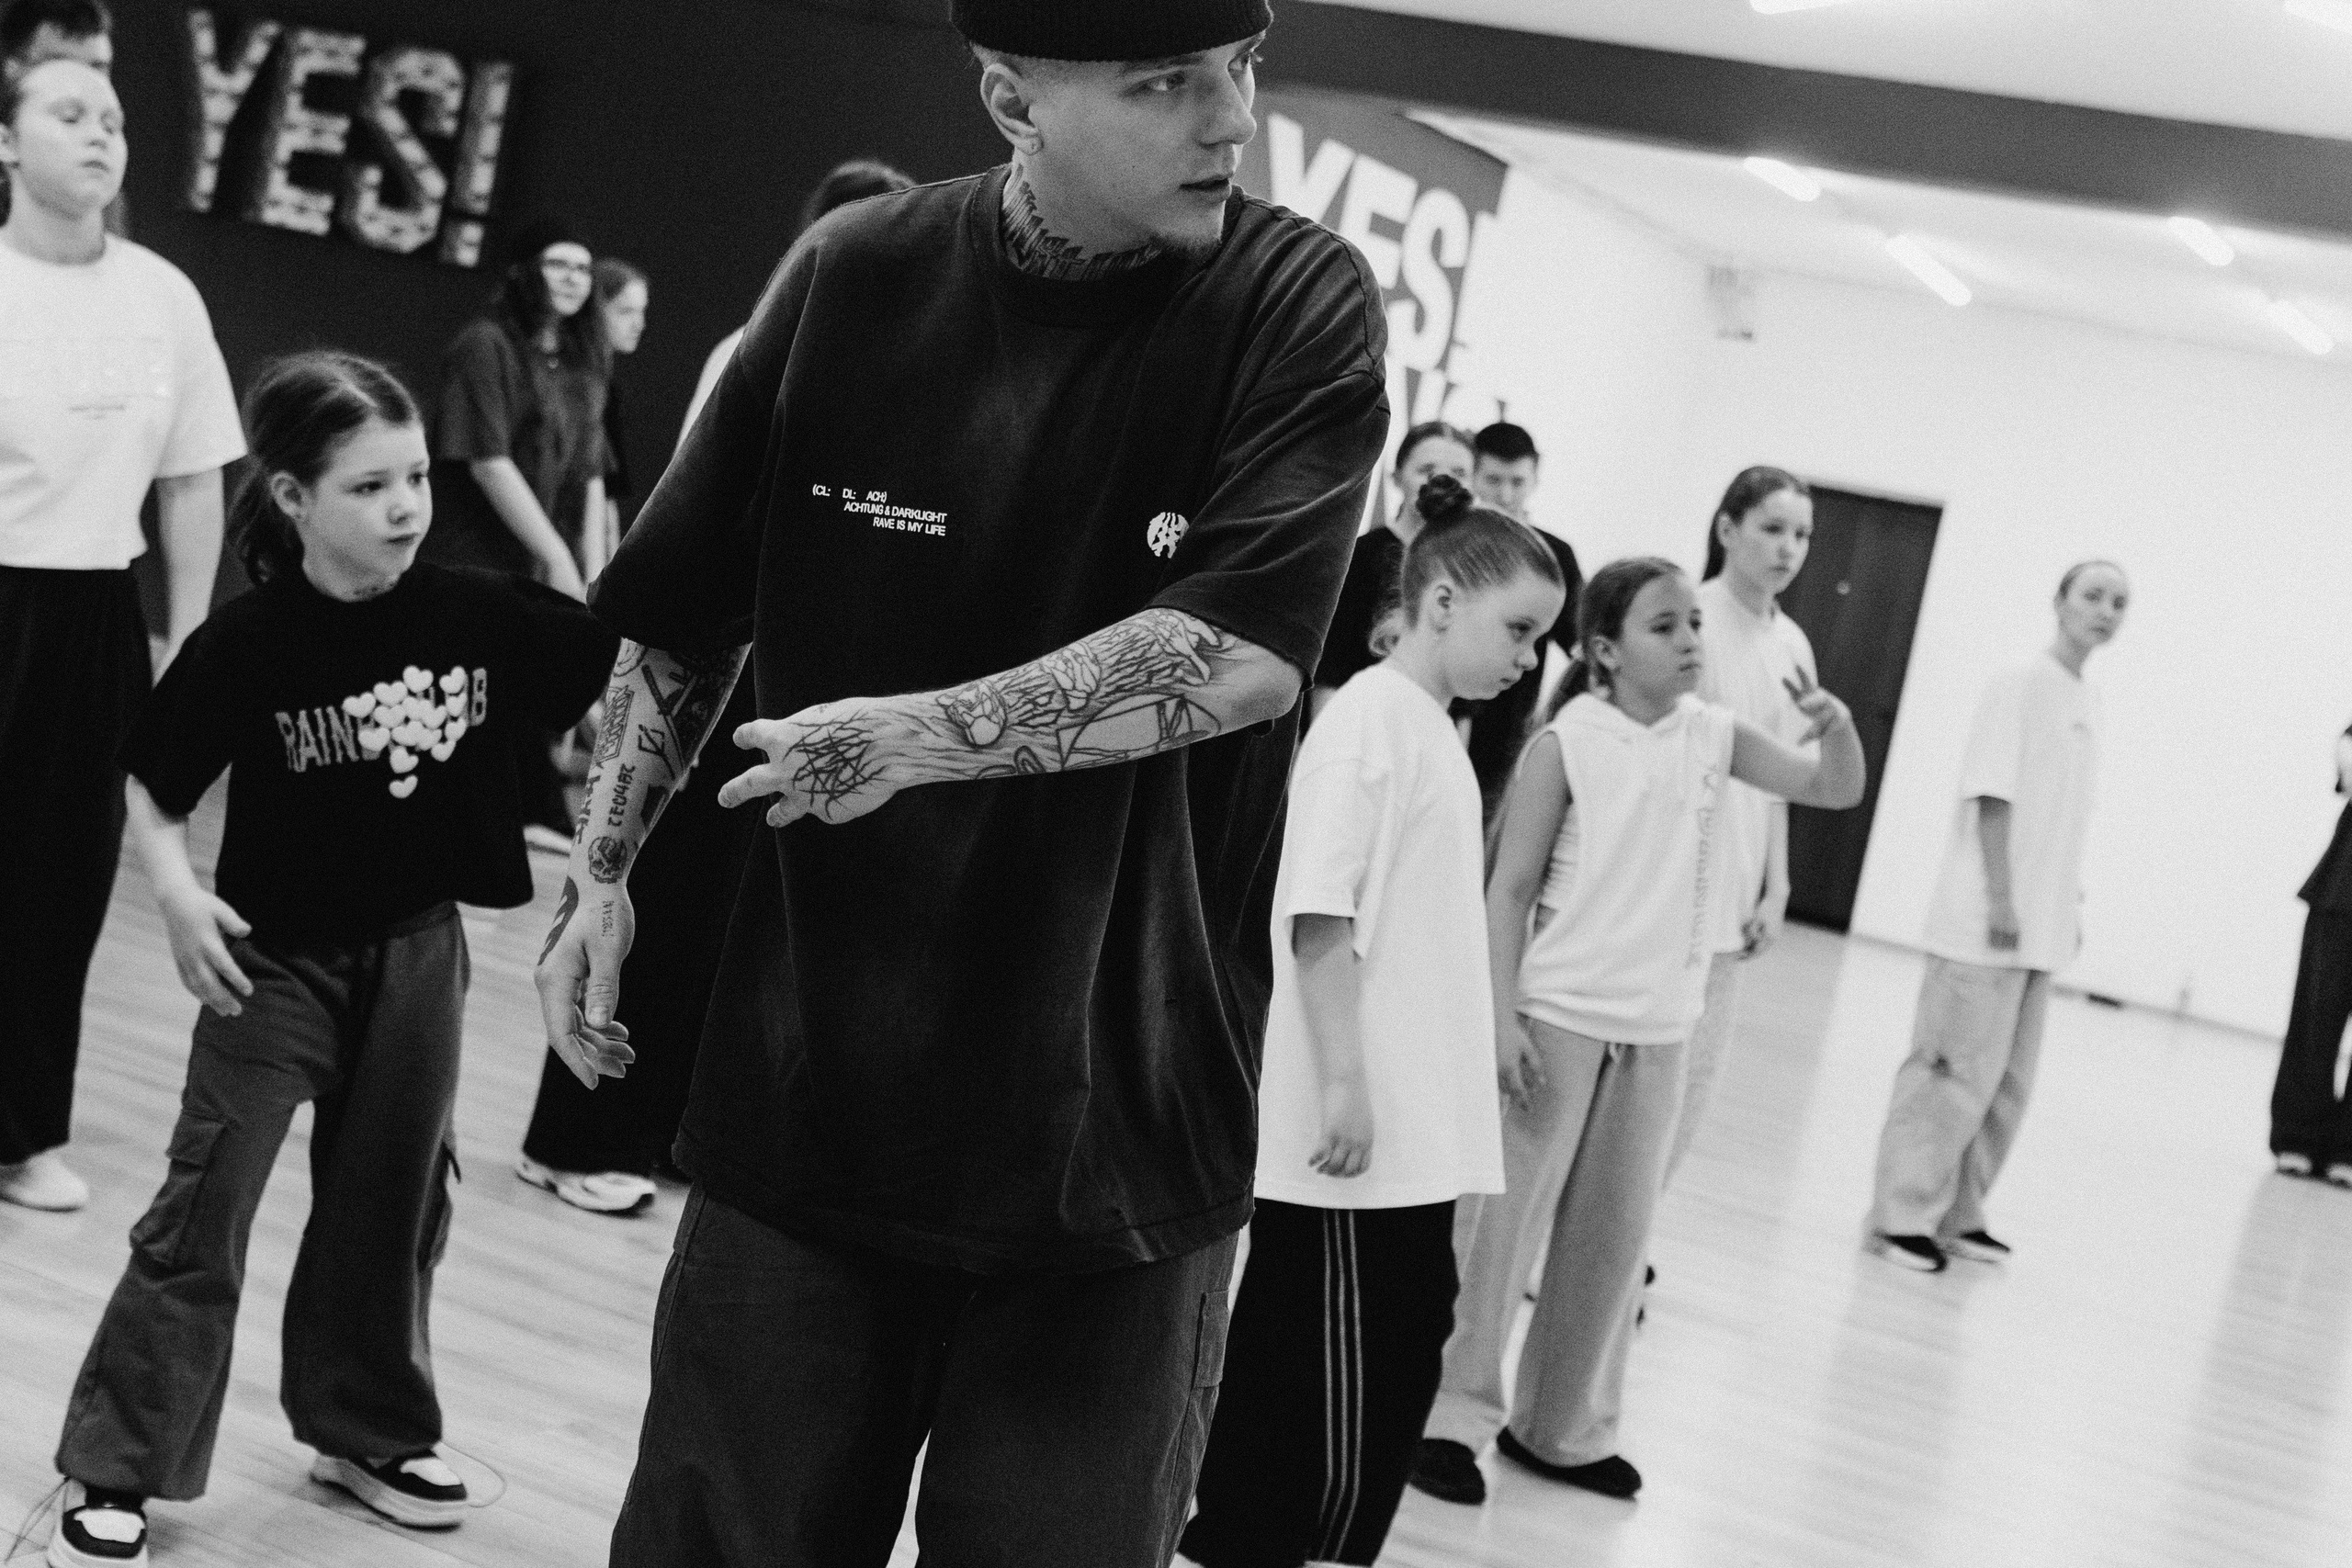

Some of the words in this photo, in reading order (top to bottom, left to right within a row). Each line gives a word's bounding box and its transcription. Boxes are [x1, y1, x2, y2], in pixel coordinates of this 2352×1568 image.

[187, 7, 512, 267] YES!
[812, 483, 831, 497] (CL:
[842, 488, 857, 500] DL:
[843, 501, 884, 515] ACHTUNG
[884, 505, 890, 516] &
[891, 505, 948, 524] DARKLIGHT
[872, 516, 895, 529] RAVE
[896, 519, 906, 530] IS
[907, 521, 923, 533] MY
[924, 523, 946, 536] LIFE
